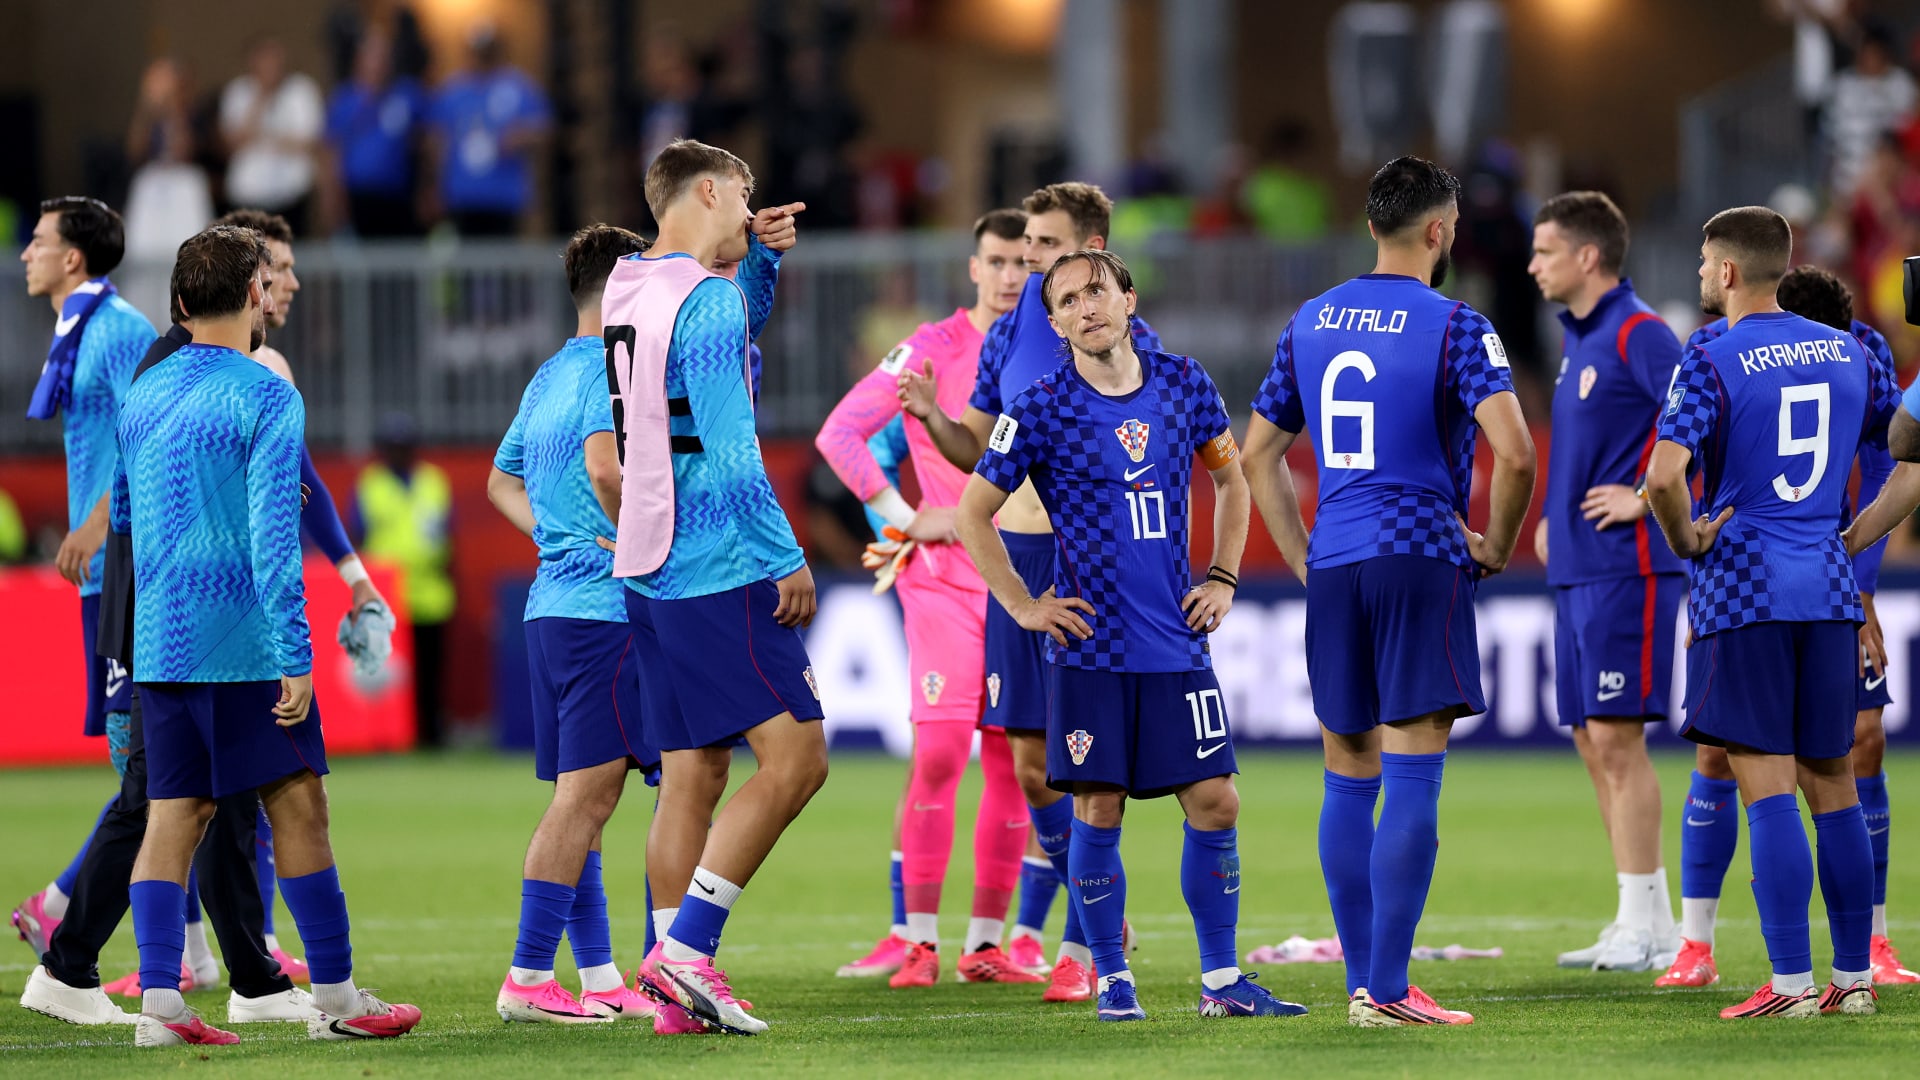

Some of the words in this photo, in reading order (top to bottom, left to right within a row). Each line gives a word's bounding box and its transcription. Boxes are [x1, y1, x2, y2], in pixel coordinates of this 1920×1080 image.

[1320, 350, 1377, 471] 6
[1772, 382, 1831, 503] 9
[1124, 490, 1167, 540] 10
[1599, 670, 1626, 690] MD
[1185, 688, 1227, 740] 10
[1079, 877, 1110, 887] HNS
[1227, 870, 1241, 878] HN
